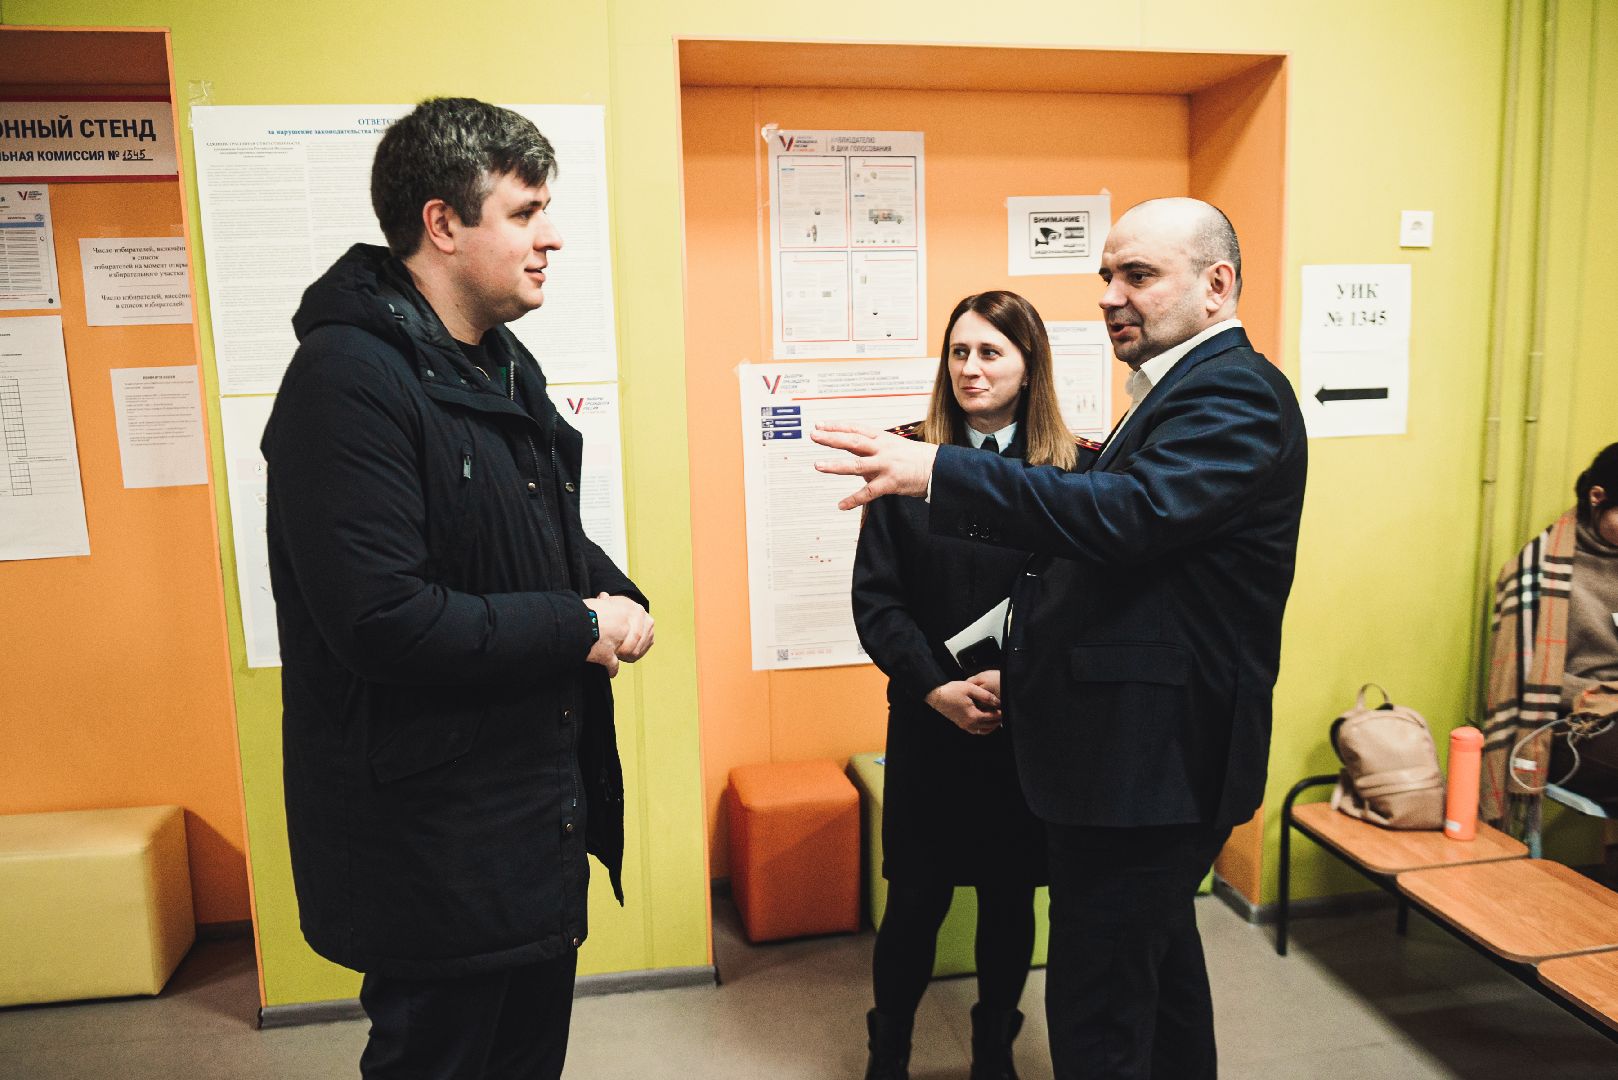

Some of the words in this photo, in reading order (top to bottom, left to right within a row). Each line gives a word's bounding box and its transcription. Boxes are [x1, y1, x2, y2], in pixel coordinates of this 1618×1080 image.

[80, 119, 156, 142] СТЕНД
[0, 150, 34, 162] ЬНАЯ
[38, 150, 104, 161] КОМИССИЯ
[108, 151, 120, 161] №
[122, 149, 146, 160] 1345
[94, 263, 133, 271] избирателей
[1336, 283, 1379, 299] УИК
[1324, 311, 1343, 327] №
[1351, 310, 1387, 327] 1345
